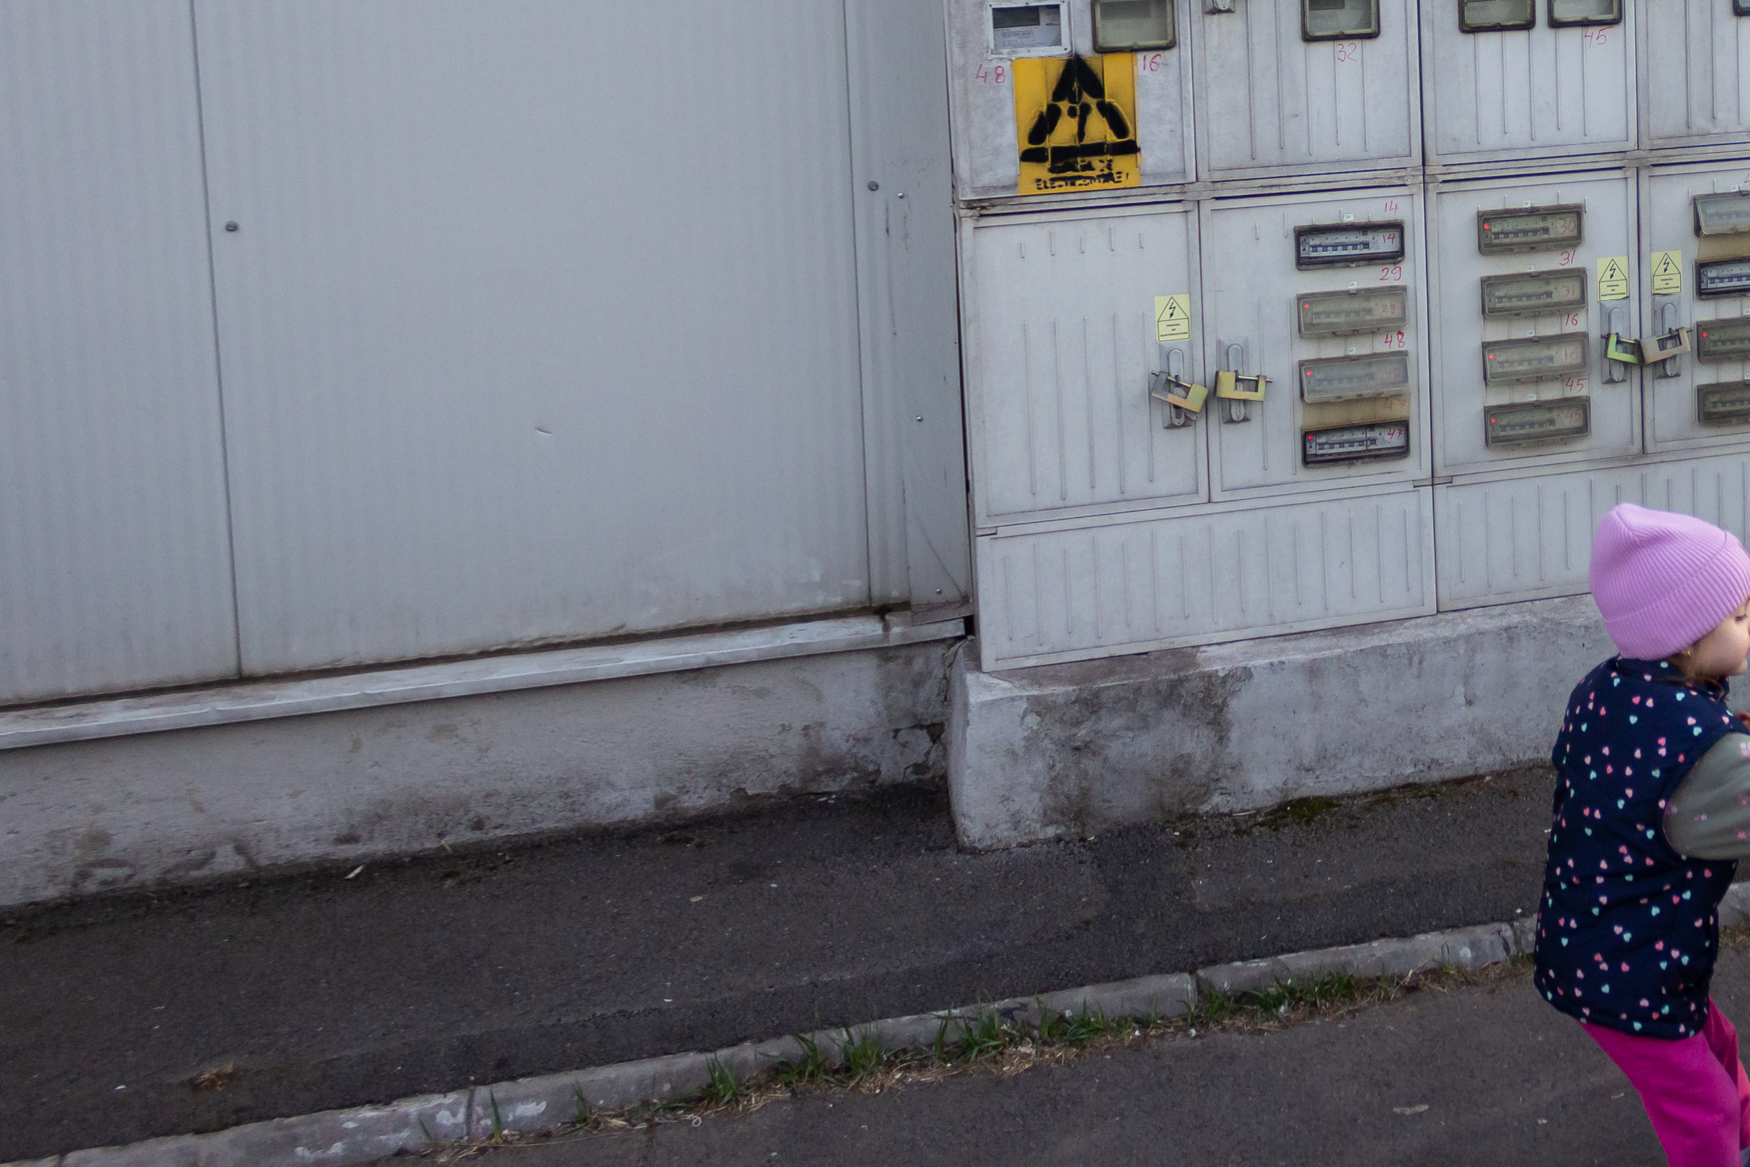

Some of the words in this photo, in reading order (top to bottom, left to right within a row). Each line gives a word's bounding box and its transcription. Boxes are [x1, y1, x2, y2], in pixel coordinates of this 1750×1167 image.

[1584, 25, 1614, 49] 45
[1337, 42, 1358, 63] 32
[1142, 53, 1162, 73] 16
[975, 64, 1007, 85] 48
[1384, 200, 1399, 215] 14
[1559, 219, 1577, 235] 30
[1382, 233, 1396, 245] 14
[1559, 249, 1576, 266] 31
[1379, 266, 1402, 281] 29
[1565, 313, 1578, 326] 16
[1384, 330, 1406, 349] 48
[1565, 377, 1587, 393] 45
